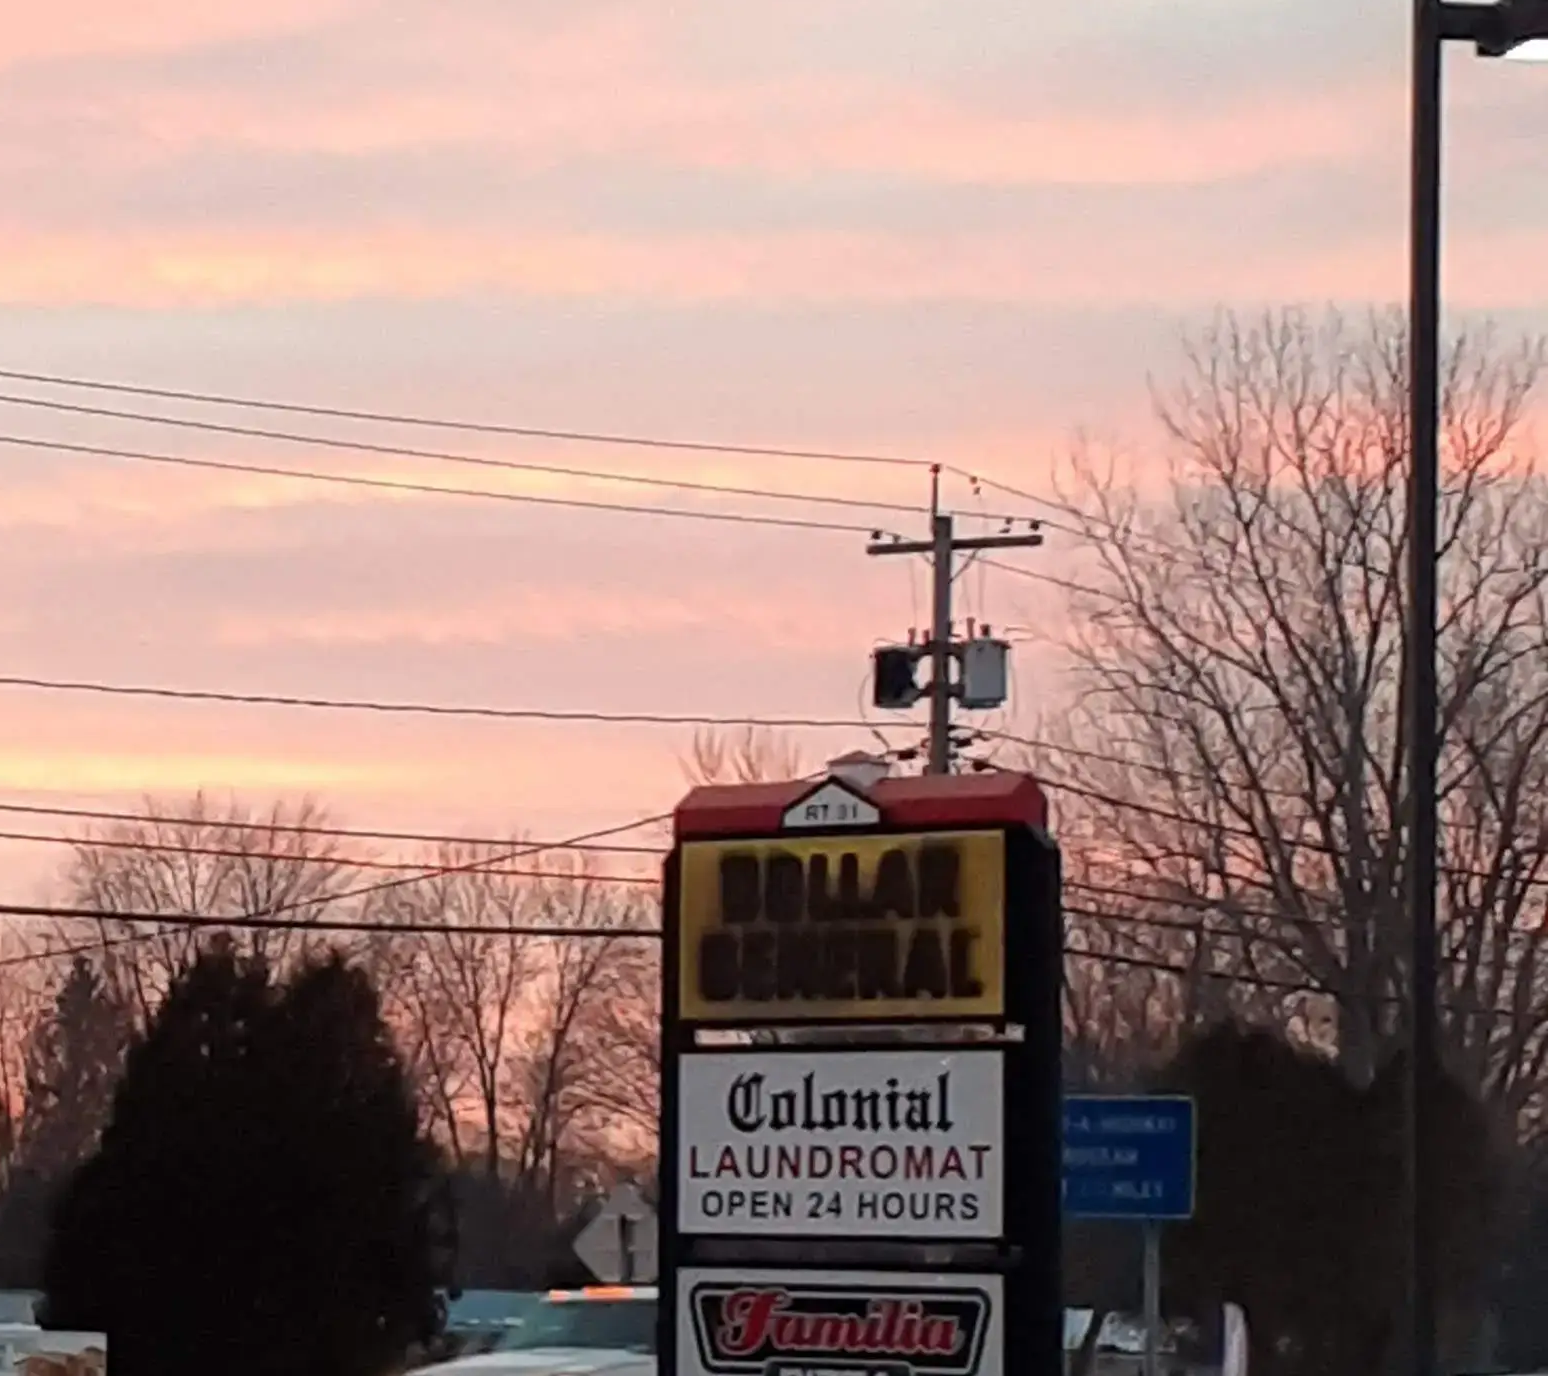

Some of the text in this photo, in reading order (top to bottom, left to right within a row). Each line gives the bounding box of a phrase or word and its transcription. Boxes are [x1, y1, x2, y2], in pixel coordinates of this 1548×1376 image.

[727, 1070, 954, 1133] Colonial
[688, 1144, 992, 1181] LAUNDROMAT
[701, 1189, 981, 1221] OPEN 24 HOURS
[716, 1287, 965, 1356] Familia
